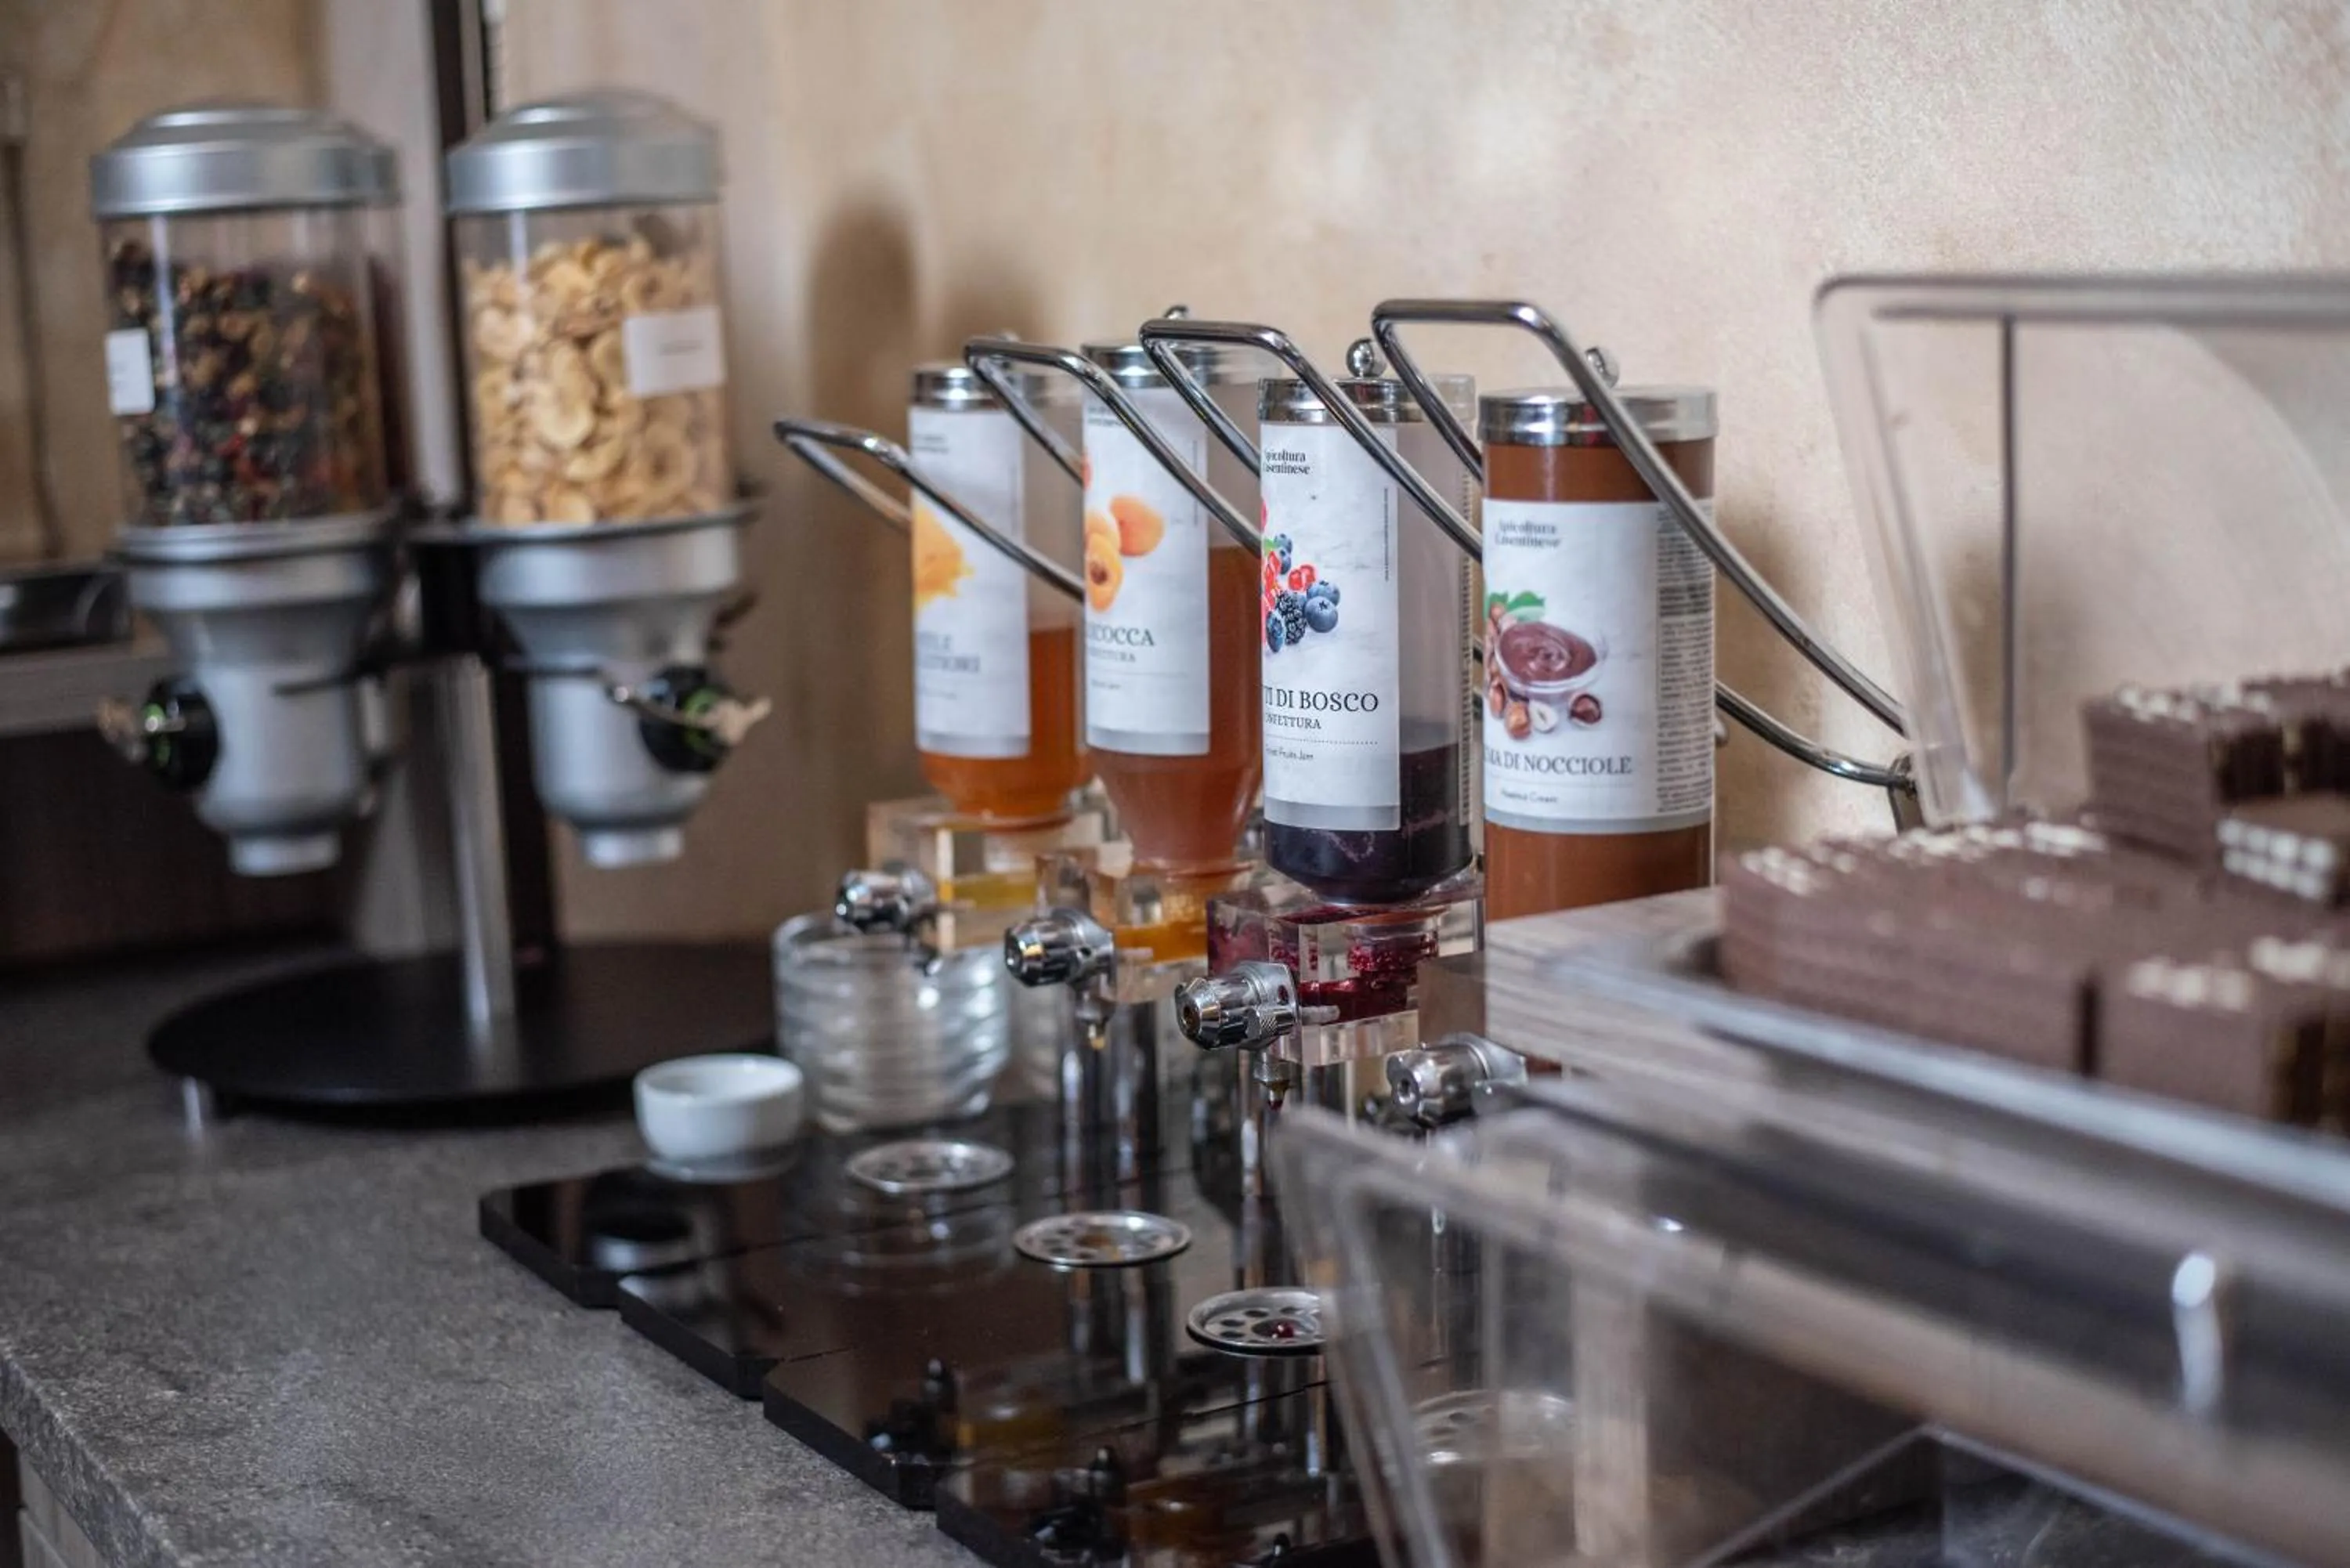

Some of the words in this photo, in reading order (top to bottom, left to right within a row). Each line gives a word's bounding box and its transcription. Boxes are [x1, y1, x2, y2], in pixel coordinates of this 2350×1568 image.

[1276, 688, 1293, 709] DI
[1299, 691, 1379, 712] BOSCO
[1524, 754, 1633, 775] NOCCIOLE
